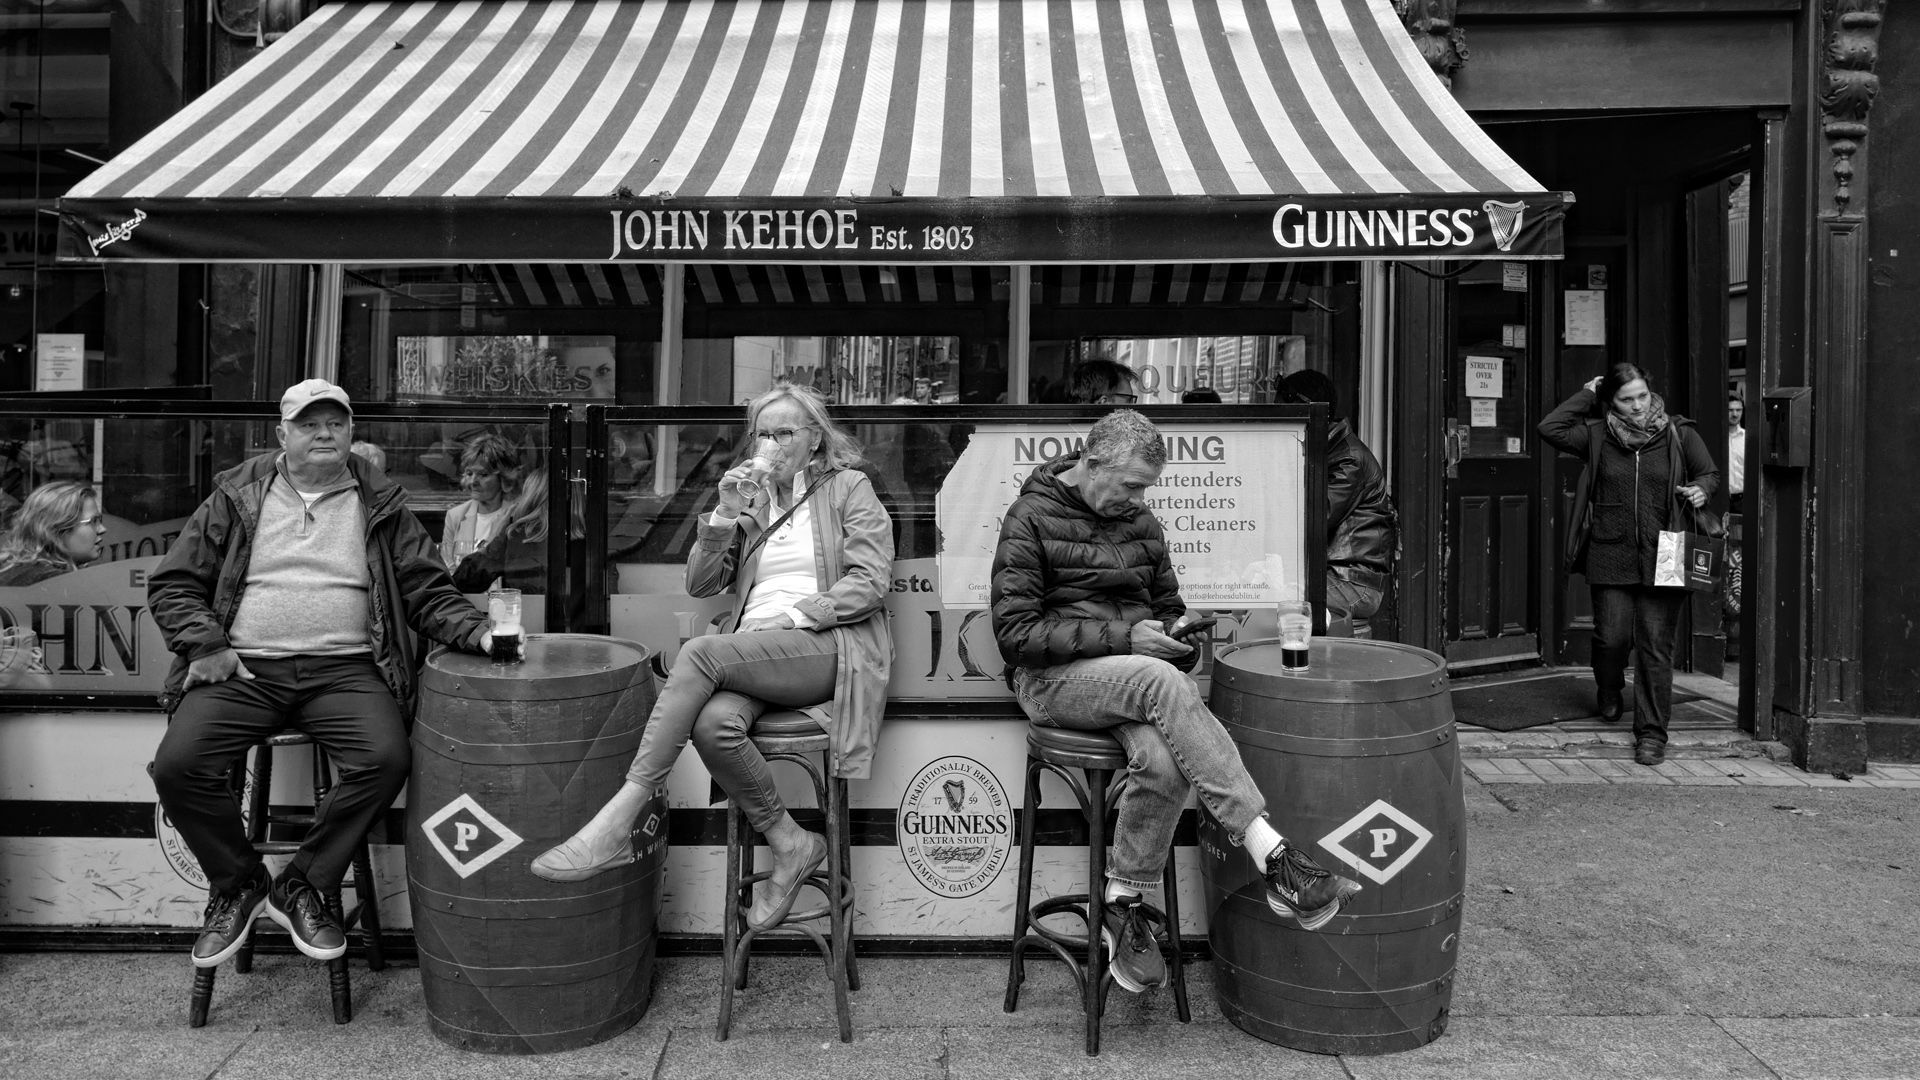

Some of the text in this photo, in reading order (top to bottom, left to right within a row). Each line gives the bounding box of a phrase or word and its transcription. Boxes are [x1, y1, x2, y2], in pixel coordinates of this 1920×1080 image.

[608, 209, 974, 260] JOHN KEHOE Est. 1803
[1272, 203, 1475, 248] GUINNESS
[1469, 361, 1498, 370] STRICTLY
[1475, 371, 1493, 380] OVER
[1166, 436, 1225, 461] ING
[1154, 471, 1243, 488] artenders
[1147, 493, 1236, 510] artenders
[1175, 515, 1256, 532] Cleaners
[1166, 540, 1212, 554] tants
[1186, 583, 1211, 592] options
[1213, 582, 1223, 590] for
[1225, 582, 1241, 592] right
[908, 762, 1002, 807] TRADITIONALLY BREWED
[903, 810, 1007, 835] GUINNESS
[454, 822, 479, 851] P
[922, 836, 989, 845] EXTRA STOUT
[1369, 828, 1397, 858] P
[948, 881, 977, 893] GATE
[980, 847, 1004, 884] DUBLIN
